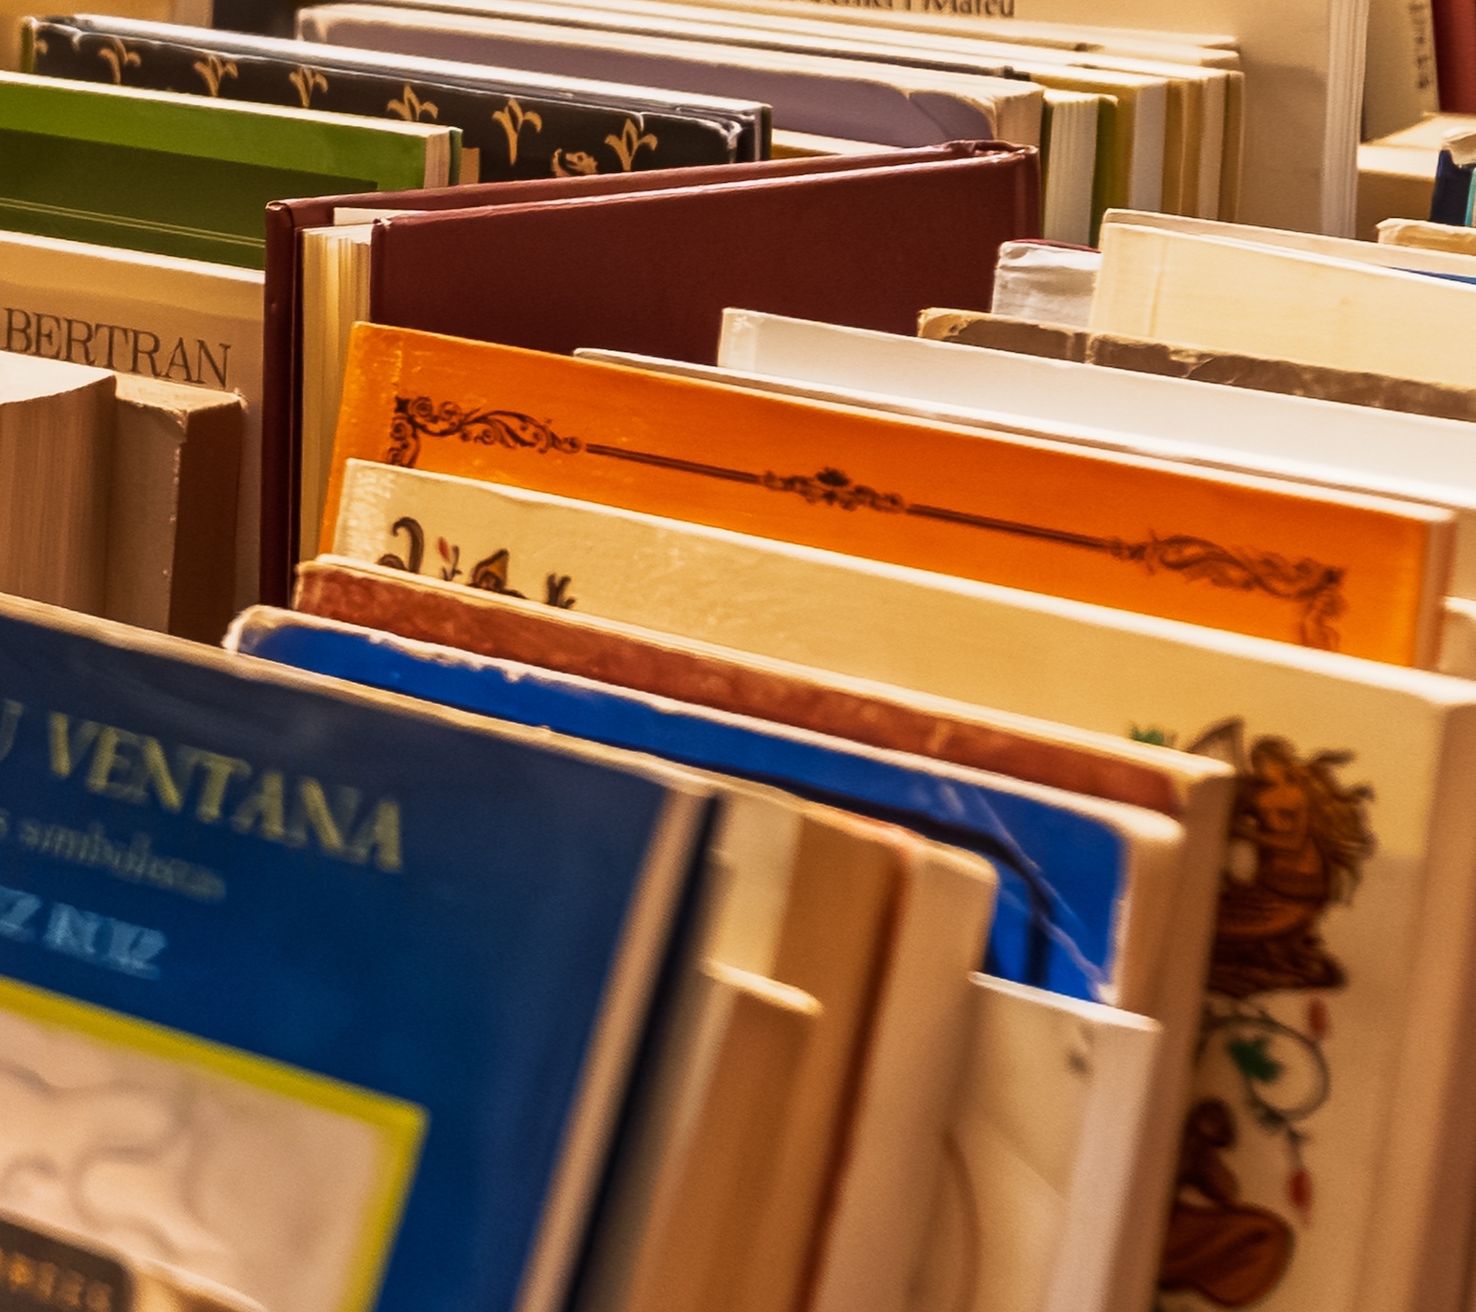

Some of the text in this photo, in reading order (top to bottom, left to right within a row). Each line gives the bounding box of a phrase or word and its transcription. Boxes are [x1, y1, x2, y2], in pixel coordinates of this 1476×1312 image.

[2, 305, 233, 389] BERTRAN
[44, 709, 406, 877] VENTANA
[43, 901, 169, 981] RUIZ
